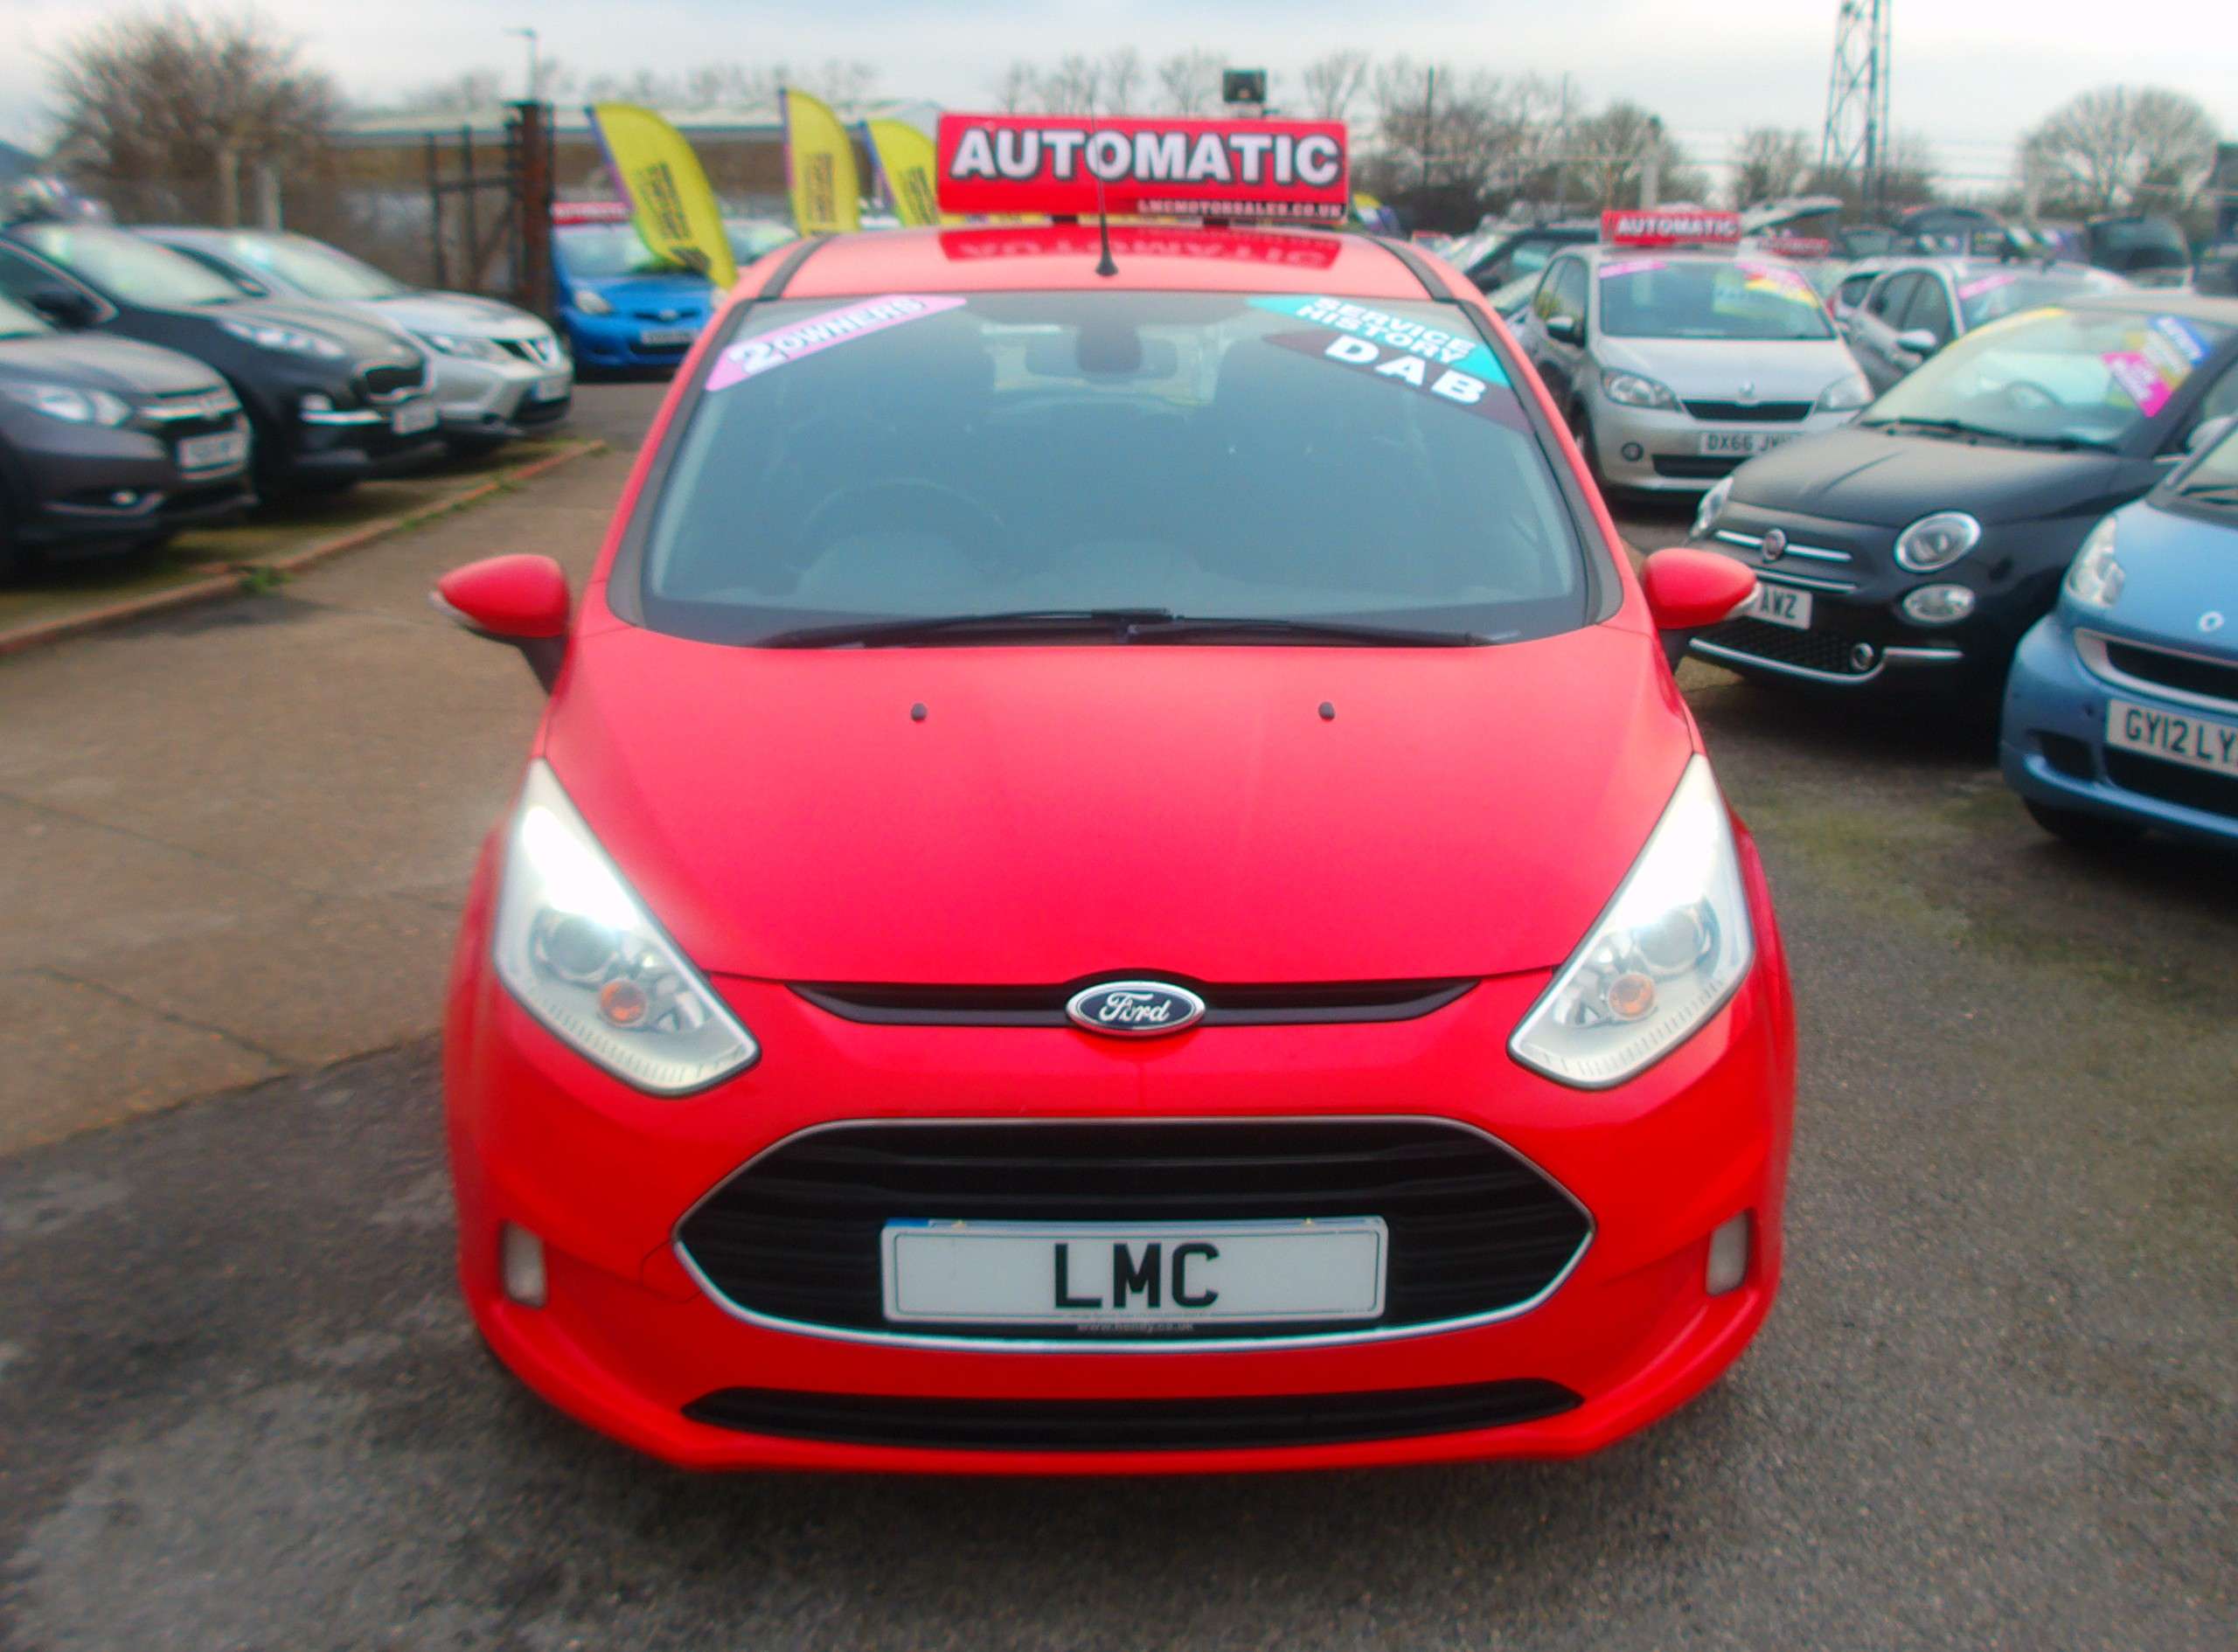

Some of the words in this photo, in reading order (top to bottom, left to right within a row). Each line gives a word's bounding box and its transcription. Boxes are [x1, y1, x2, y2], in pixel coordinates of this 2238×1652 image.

[949, 128, 1341, 185] AUTOMATIC
[1616, 217, 1738, 236] AUTOMATIC
[726, 342, 787, 375] 2
[775, 297, 927, 354] OWNERS
[1296, 305, 1473, 364] HISTORY
[1313, 296, 1477, 351] SERVICE
[1324, 335, 1486, 404] DAB
[2126, 709, 2188, 753] GY12
[1099, 991, 1171, 1022] Ford
[1053, 1242, 1220, 1309] LMC
